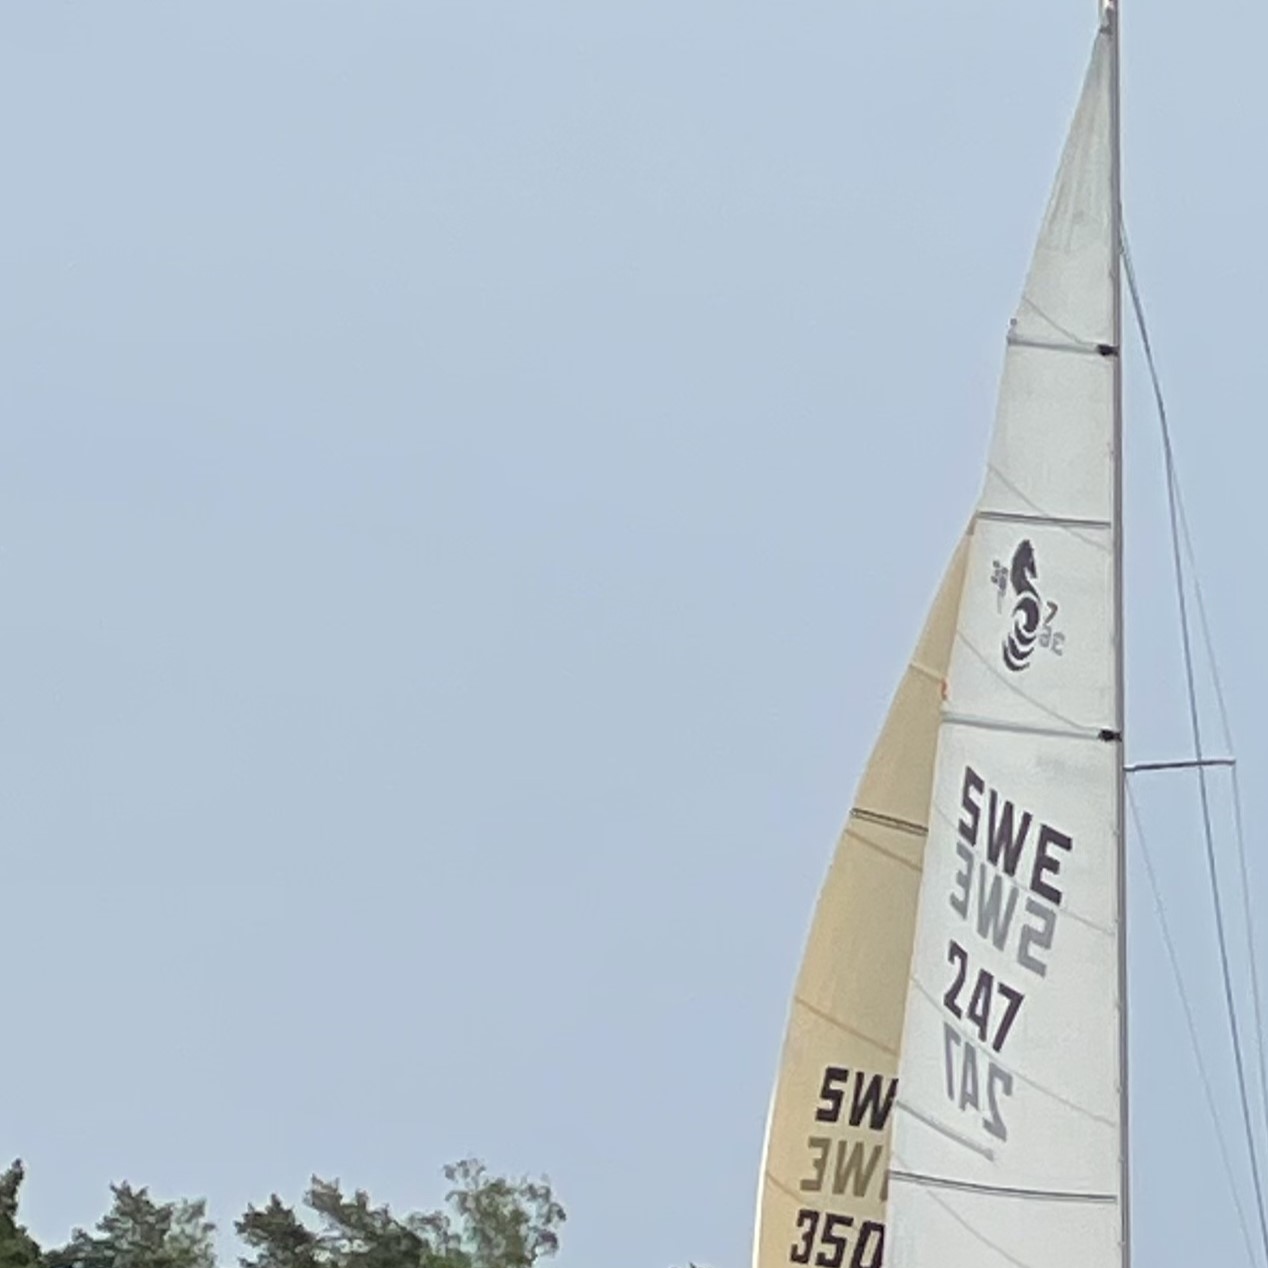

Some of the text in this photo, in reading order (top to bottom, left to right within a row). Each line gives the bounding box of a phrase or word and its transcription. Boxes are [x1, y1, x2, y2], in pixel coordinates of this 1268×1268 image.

[958, 766, 1073, 906] SWE
[943, 940, 1025, 1053] 247
[815, 1066, 899, 1131] SW
